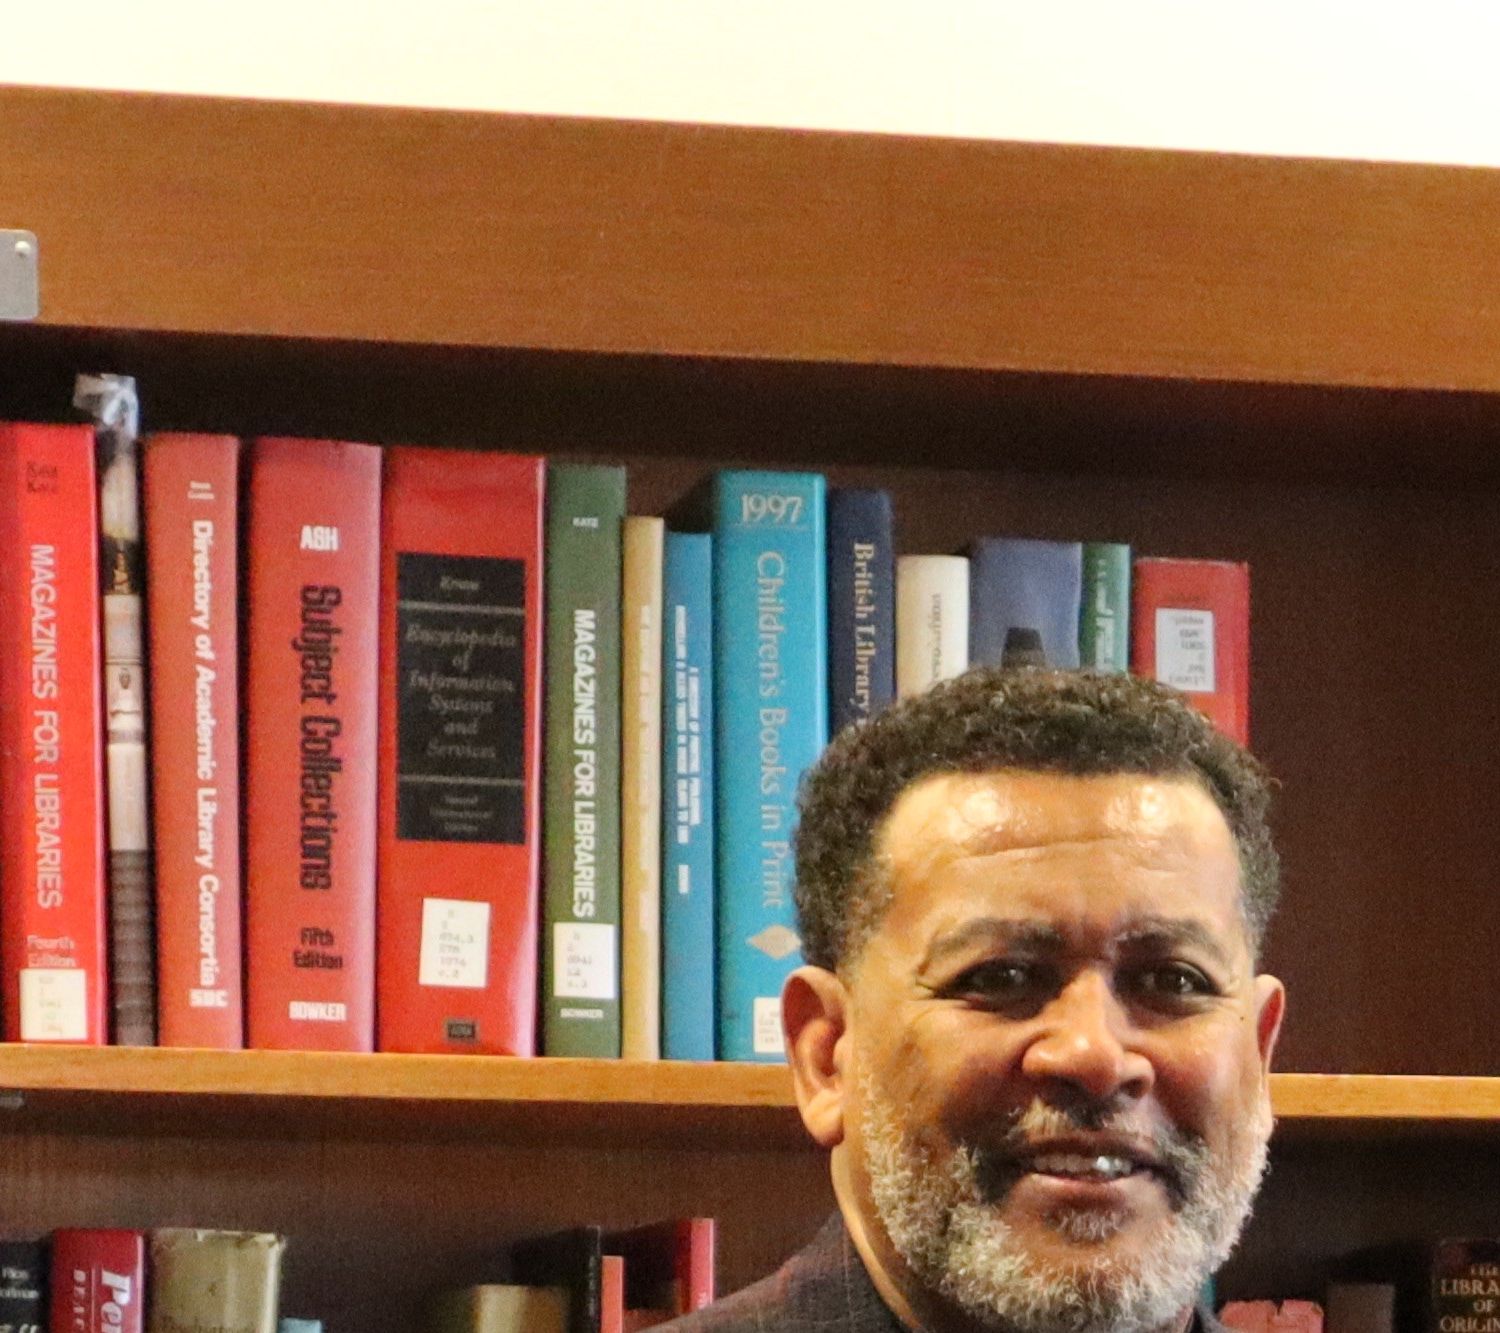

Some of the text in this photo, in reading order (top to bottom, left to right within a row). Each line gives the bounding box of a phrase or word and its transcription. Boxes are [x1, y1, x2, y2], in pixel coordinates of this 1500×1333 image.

[299, 526, 339, 552] ASH
[740, 493, 804, 524] 1997
[848, 542, 877, 712] British Library
[29, 544, 63, 909] MAGAZINES FOR LIBRARIES
[408, 665, 516, 696] Information
[756, 550, 790, 909] Children's Books in Print
[190, 521, 222, 987] Directory of Academic Library Consortia
[290, 584, 344, 890] Subject Collections
[572, 608, 598, 920] MAGAZINES FOR LIBRARIES
[292, 949, 344, 972] Edition
[288, 1001, 347, 1021] BOWKER
[1472, 1298, 1498, 1314] OF
